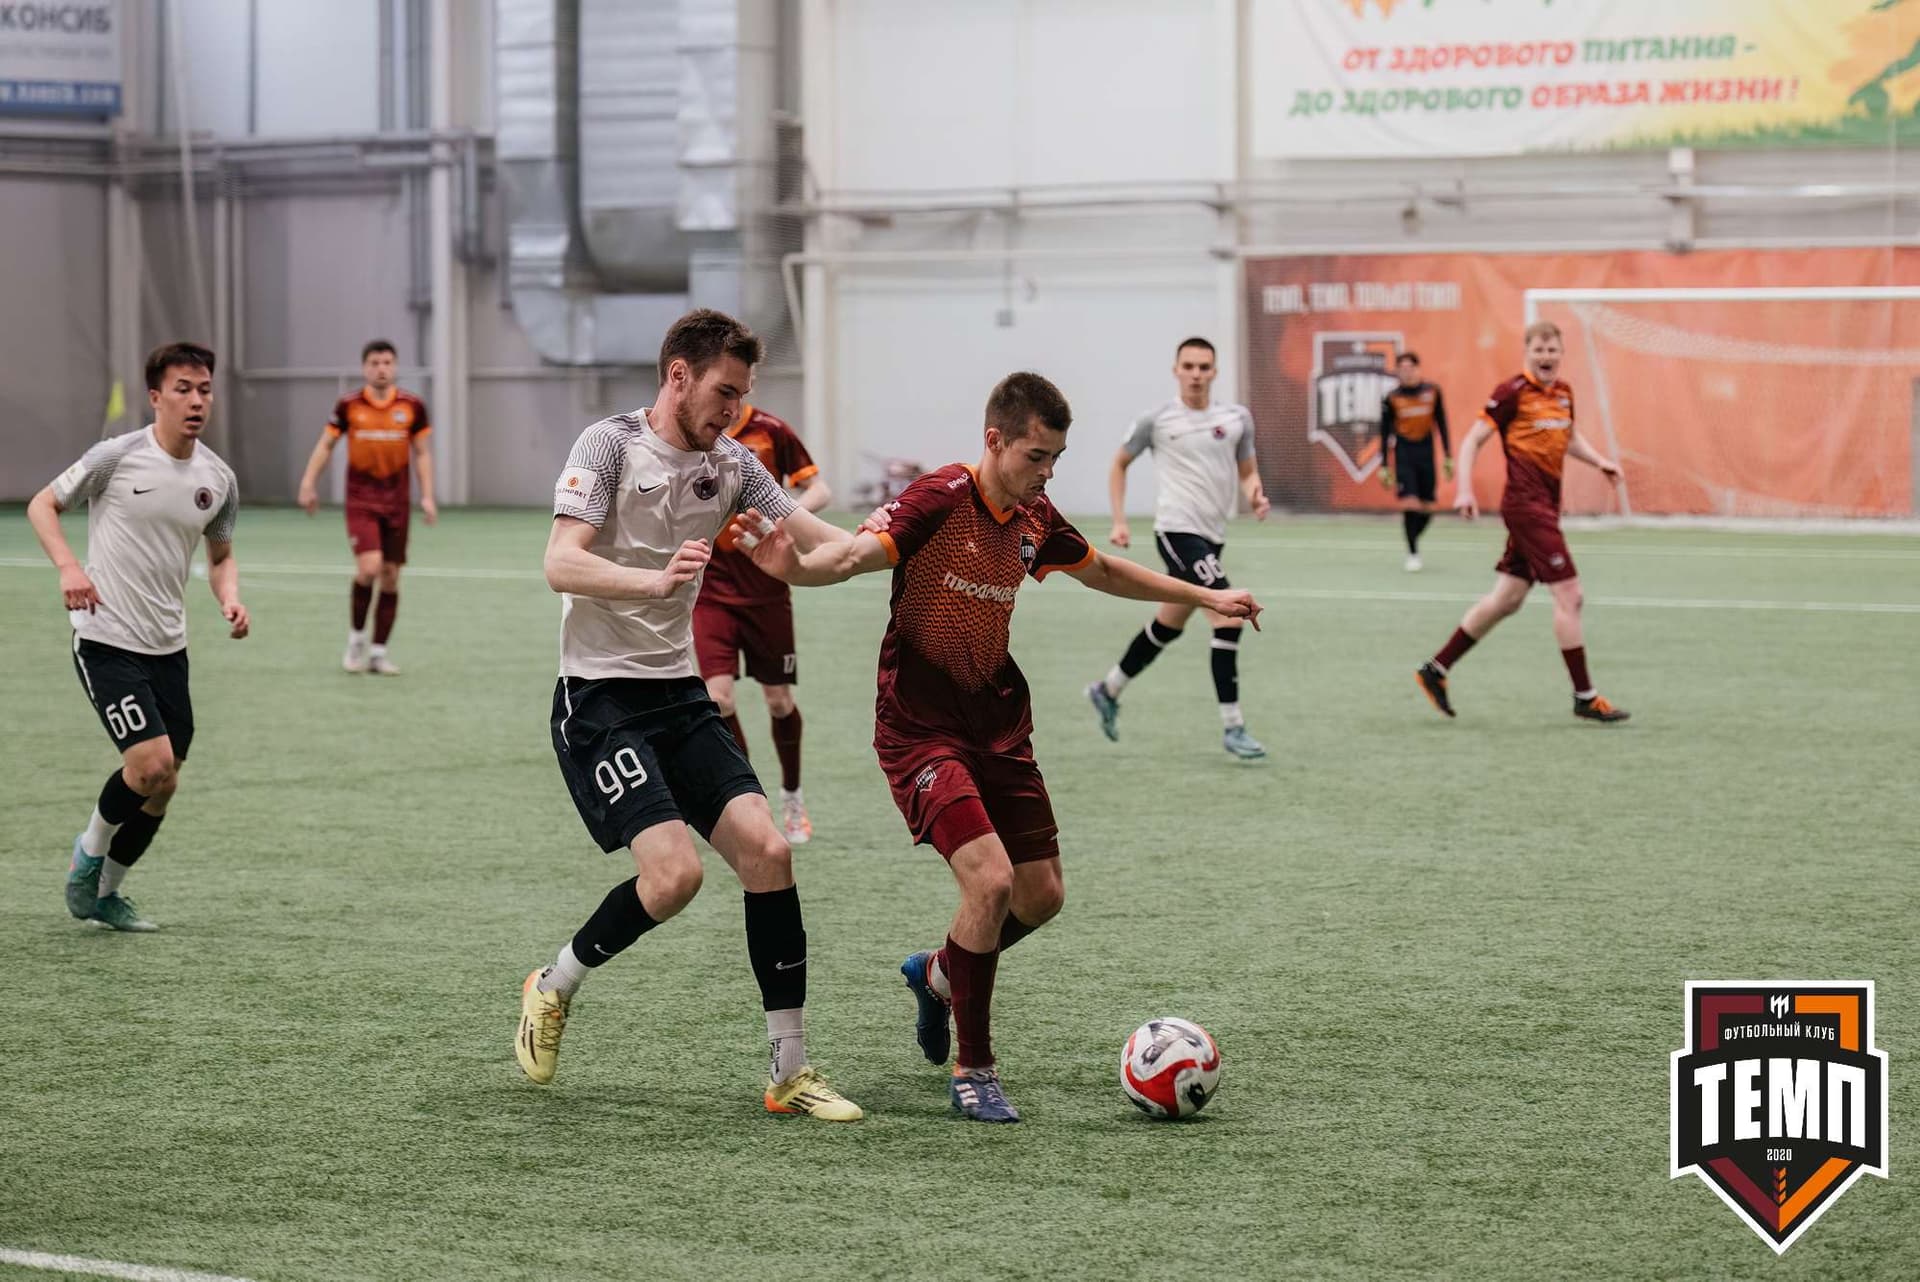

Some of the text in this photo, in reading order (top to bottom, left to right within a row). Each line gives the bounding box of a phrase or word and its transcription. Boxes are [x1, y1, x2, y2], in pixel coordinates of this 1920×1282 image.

[1342, 47, 1381, 72] ОТ
[1388, 40, 1575, 74] ЗДОРОВОГО
[1581, 35, 1737, 63] ПИТАНИЯ
[1288, 89, 1334, 118] ДО
[1340, 84, 1523, 116] ЗДОРОВОГО
[1530, 80, 1650, 108] ОБРАЗА
[106, 695, 147, 740] 66
[595, 747, 648, 805] 99
